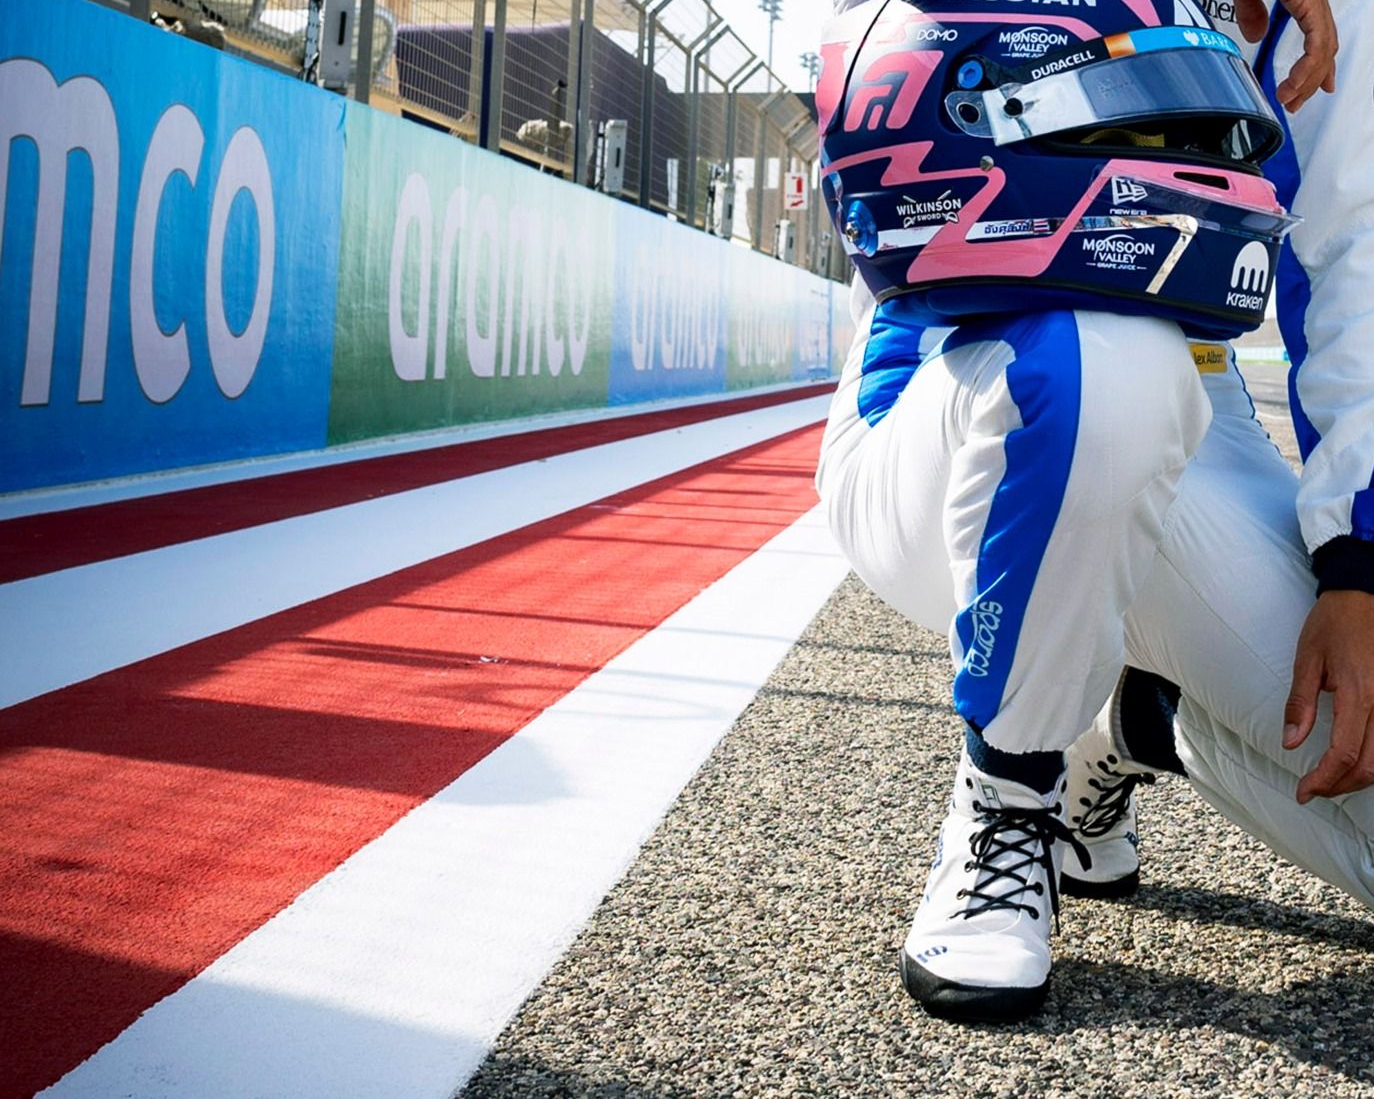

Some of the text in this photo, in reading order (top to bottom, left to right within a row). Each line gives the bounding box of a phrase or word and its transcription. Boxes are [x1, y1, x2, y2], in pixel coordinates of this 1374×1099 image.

[916, 29, 958, 42] DOMO
[1013, 43, 1050, 53] VALLEY
[1031, 50, 1095, 80] DURACELL
[896, 198, 961, 216] WILKINSON
[917, 213, 941, 222] SWORD
[1099, 252, 1136, 264] VALLEY
[389, 172, 591, 382] aramco
[968, 600, 1004, 678] sparco
